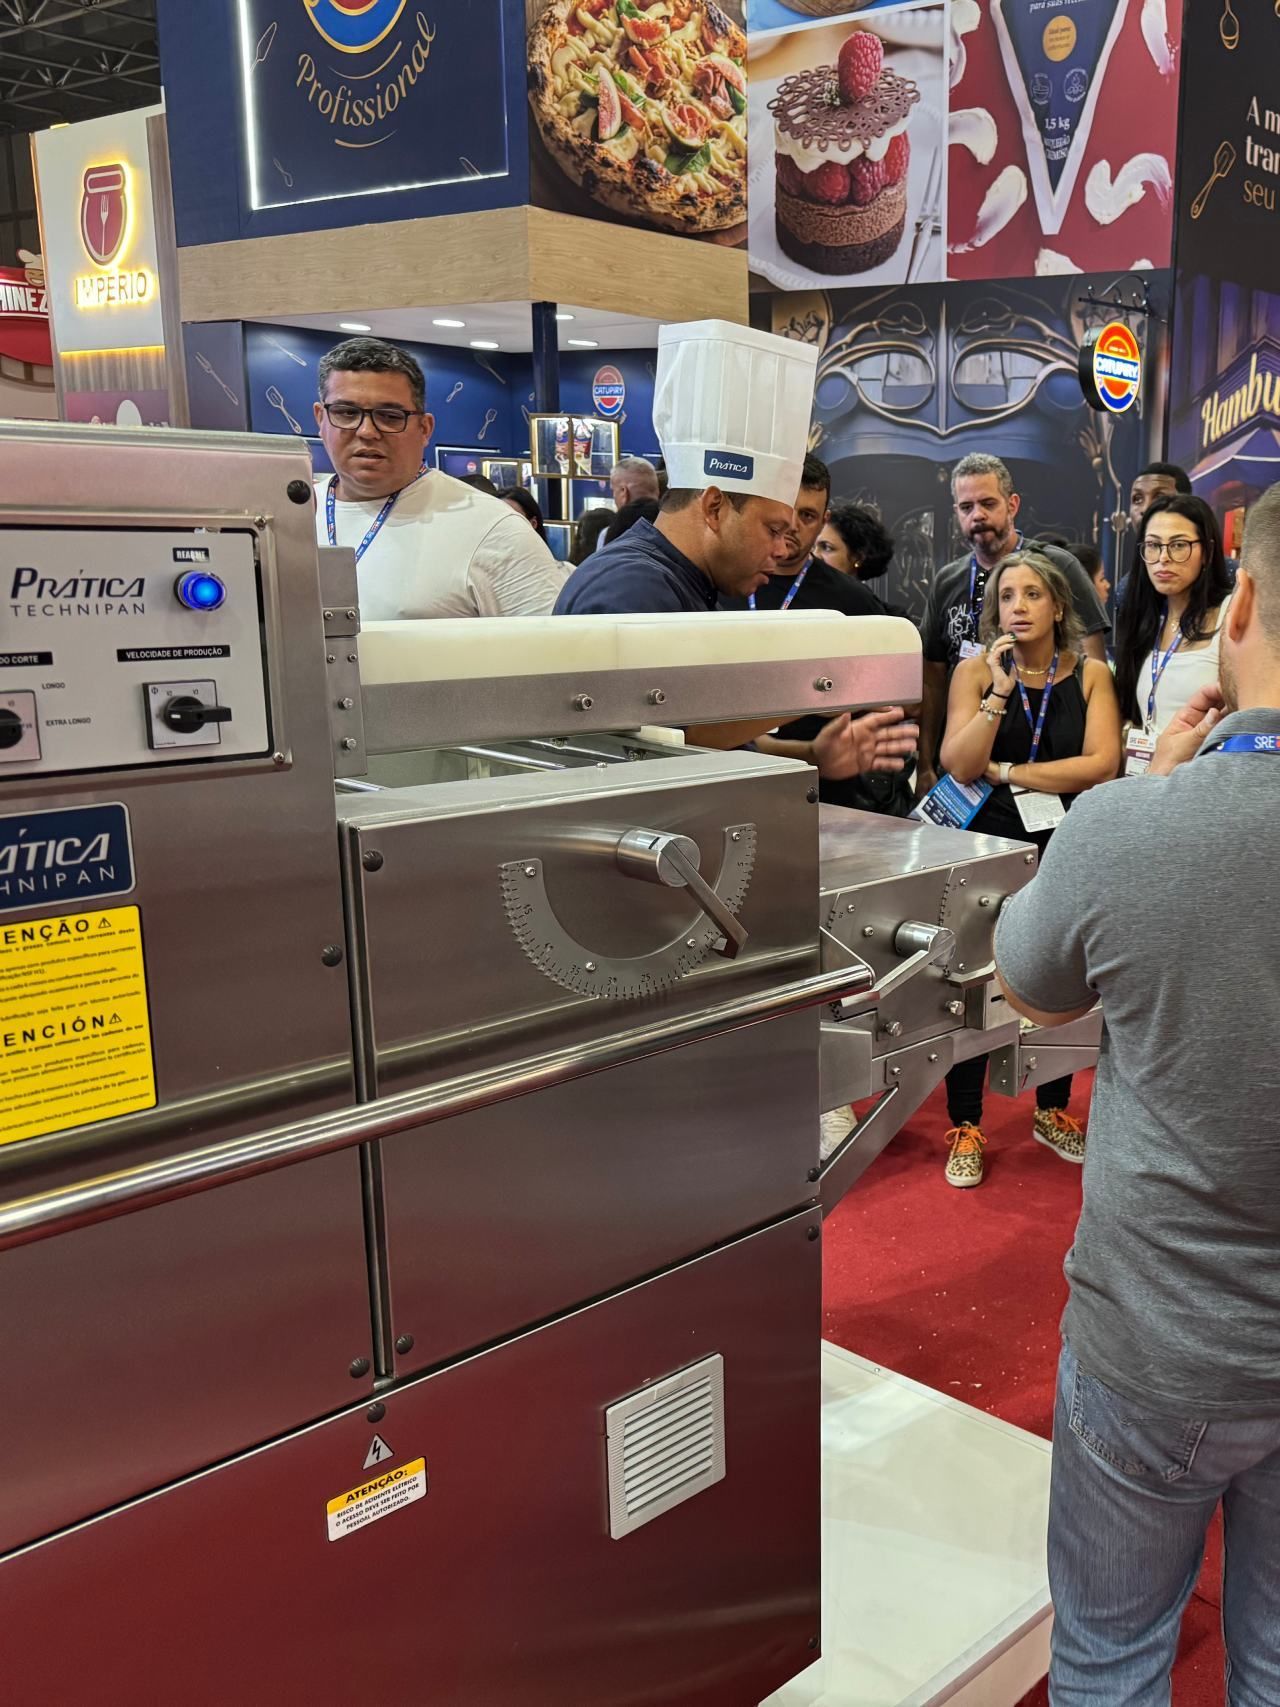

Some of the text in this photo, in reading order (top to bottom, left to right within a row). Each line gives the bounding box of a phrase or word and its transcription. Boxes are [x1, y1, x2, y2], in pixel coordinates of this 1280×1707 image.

[296, 11, 436, 126] Profissional
[1246, 96, 1260, 126] A
[1058, 116, 1070, 130] kg
[1243, 180, 1275, 211] seu
[10, 602, 146, 617] TECHNIPAN
[11, 655, 39, 664] CORTE
[126, 647, 223, 659] VELOCIDADE DE PRODUÇÃO
[41, 682, 66, 690] LONGO
[46, 719, 68, 727] EXTRA
[1254, 735, 1276, 749] SRE
[3, 1014, 105, 1047] ENCIÓN
[346, 1469, 408, 1504] ATENÇÃO:
[342, 1510, 364, 1525] ACESSO
[407, 1482, 420, 1492] POR
[337, 1506, 354, 1518] RISCO
[346, 1514, 371, 1530] PESSOAL
